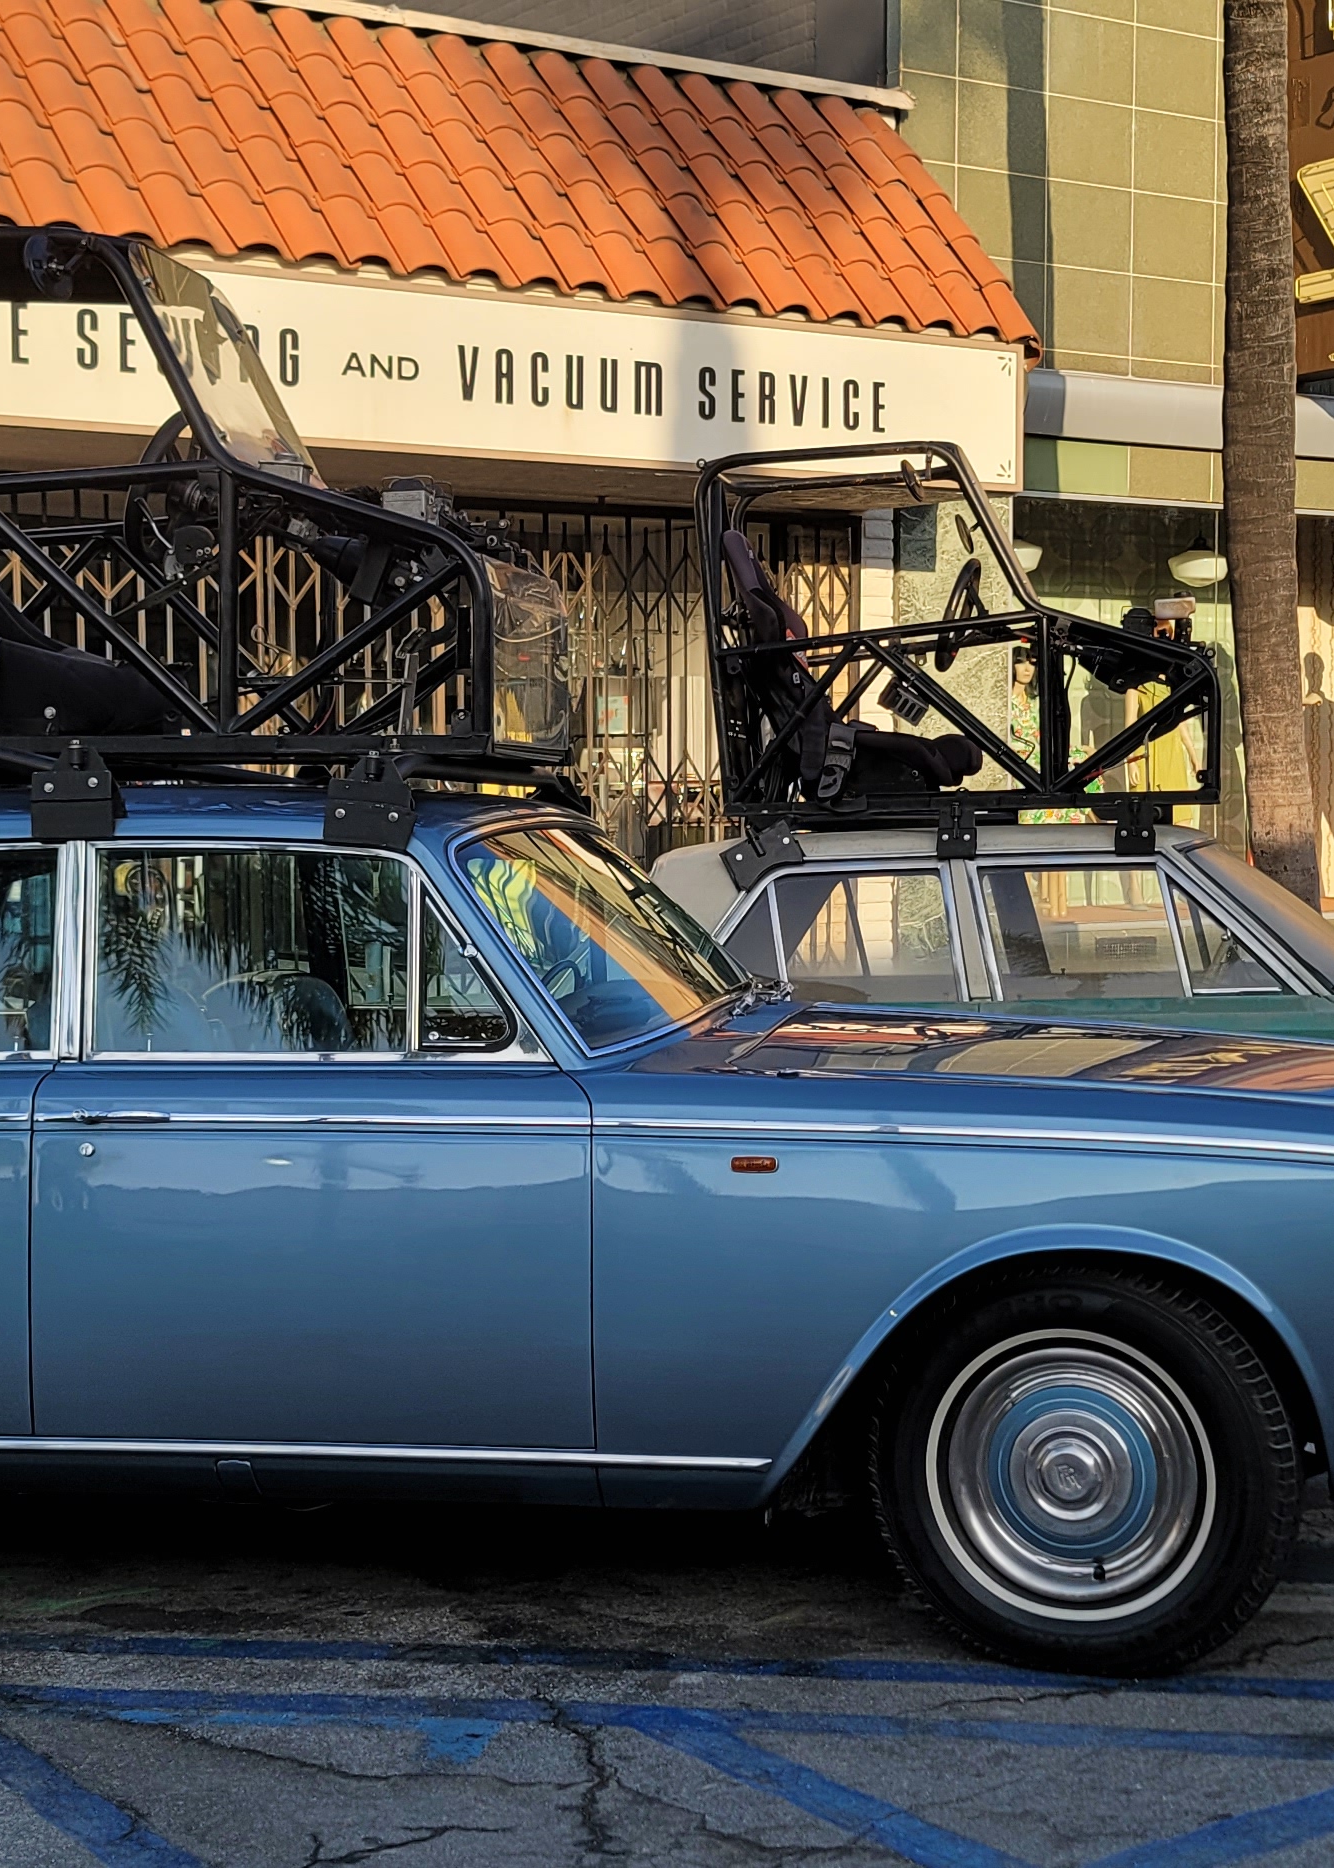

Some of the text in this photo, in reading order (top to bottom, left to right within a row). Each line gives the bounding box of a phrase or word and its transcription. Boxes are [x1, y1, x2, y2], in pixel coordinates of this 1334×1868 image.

[341, 352, 420, 382] AND
[457, 344, 664, 417] VACUUM
[698, 366, 887, 433] SERVICE
